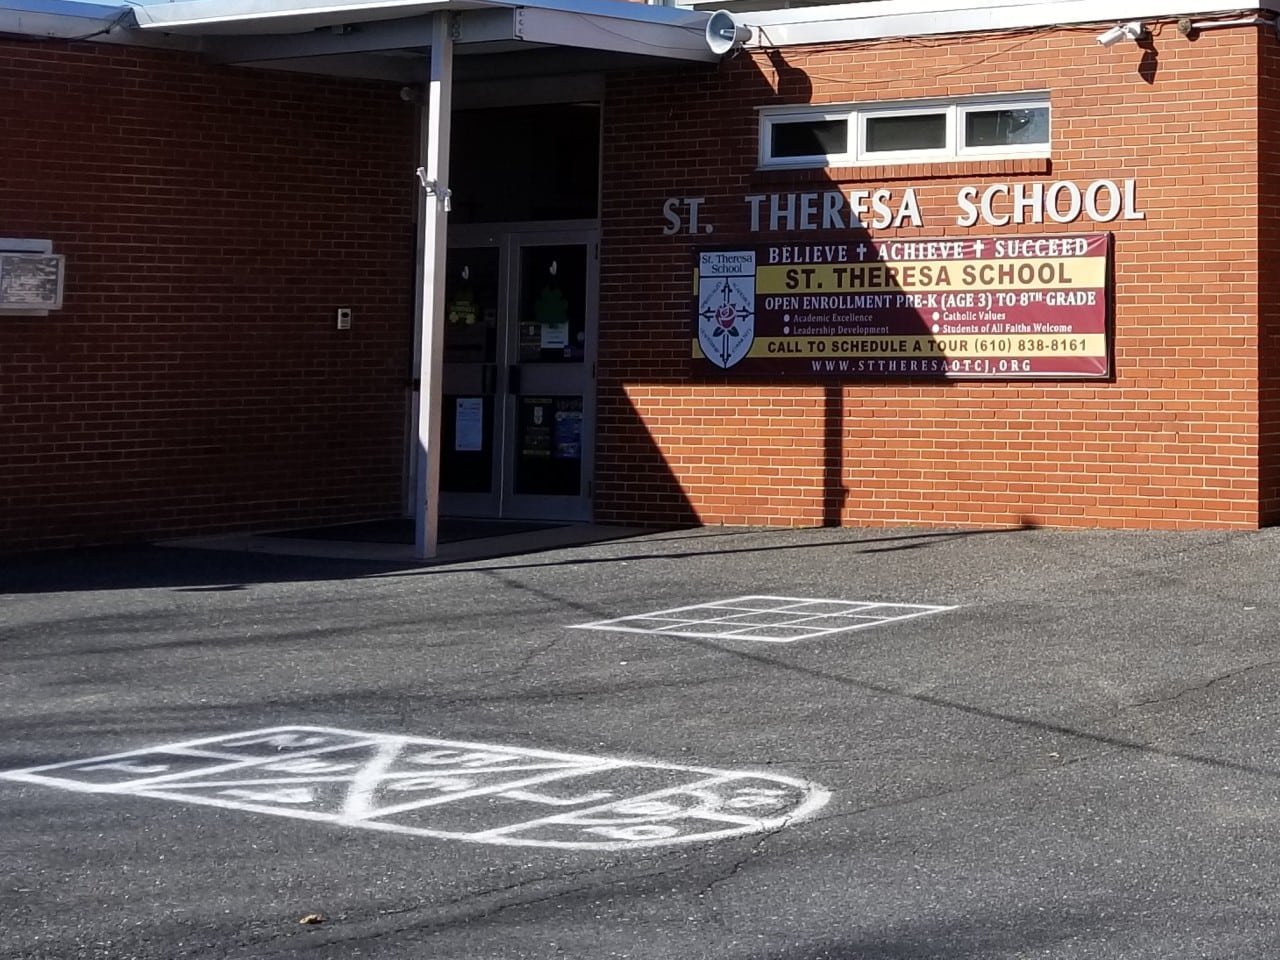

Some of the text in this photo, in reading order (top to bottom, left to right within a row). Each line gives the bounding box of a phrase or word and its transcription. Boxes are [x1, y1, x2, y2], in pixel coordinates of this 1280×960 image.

[663, 178, 1145, 235] ST. THERESA SCHOOL
[768, 237, 1088, 264] BELIEVE ACHIEVE SUCCEED
[717, 253, 753, 264] Theresa
[711, 262, 743, 274] School
[784, 262, 1073, 290] ST. THERESA SCHOOL
[764, 290, 1097, 311] OPEN ENROLLMENT PRE-K (AGE 3) TO 8TH GRADE
[793, 312, 873, 323] Academic Excellence
[943, 310, 1007, 321] Catholic Values
[793, 324, 889, 336] Leadership Development
[942, 322, 1073, 334] Students of All Faiths Welcome
[767, 338, 1087, 354] CALL TO SCHEDULE A TOUR (610) 838-8161
